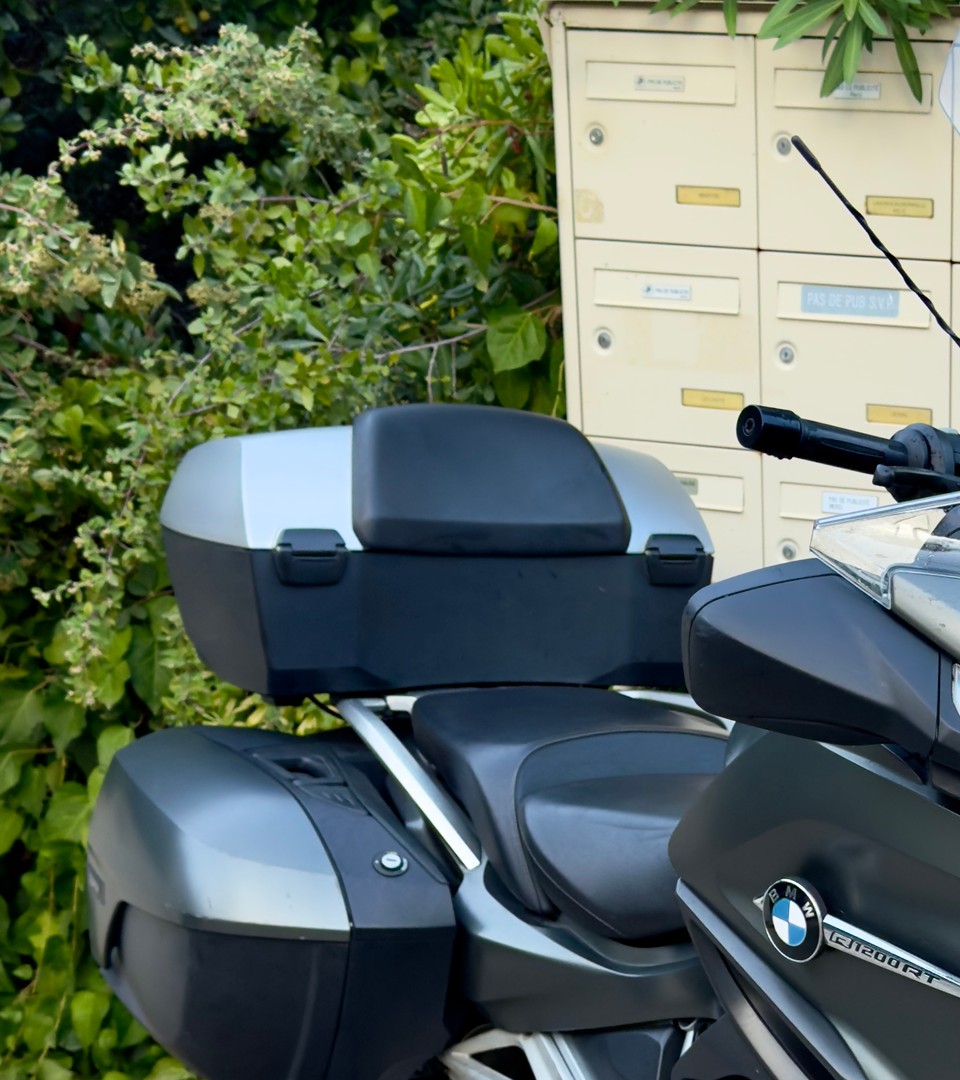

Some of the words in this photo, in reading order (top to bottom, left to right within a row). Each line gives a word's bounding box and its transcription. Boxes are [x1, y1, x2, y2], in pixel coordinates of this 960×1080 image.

[806, 292, 826, 307] PAS
[828, 293, 841, 308] DE
[845, 294, 866, 309] PUB
[767, 884, 816, 919] BMW
